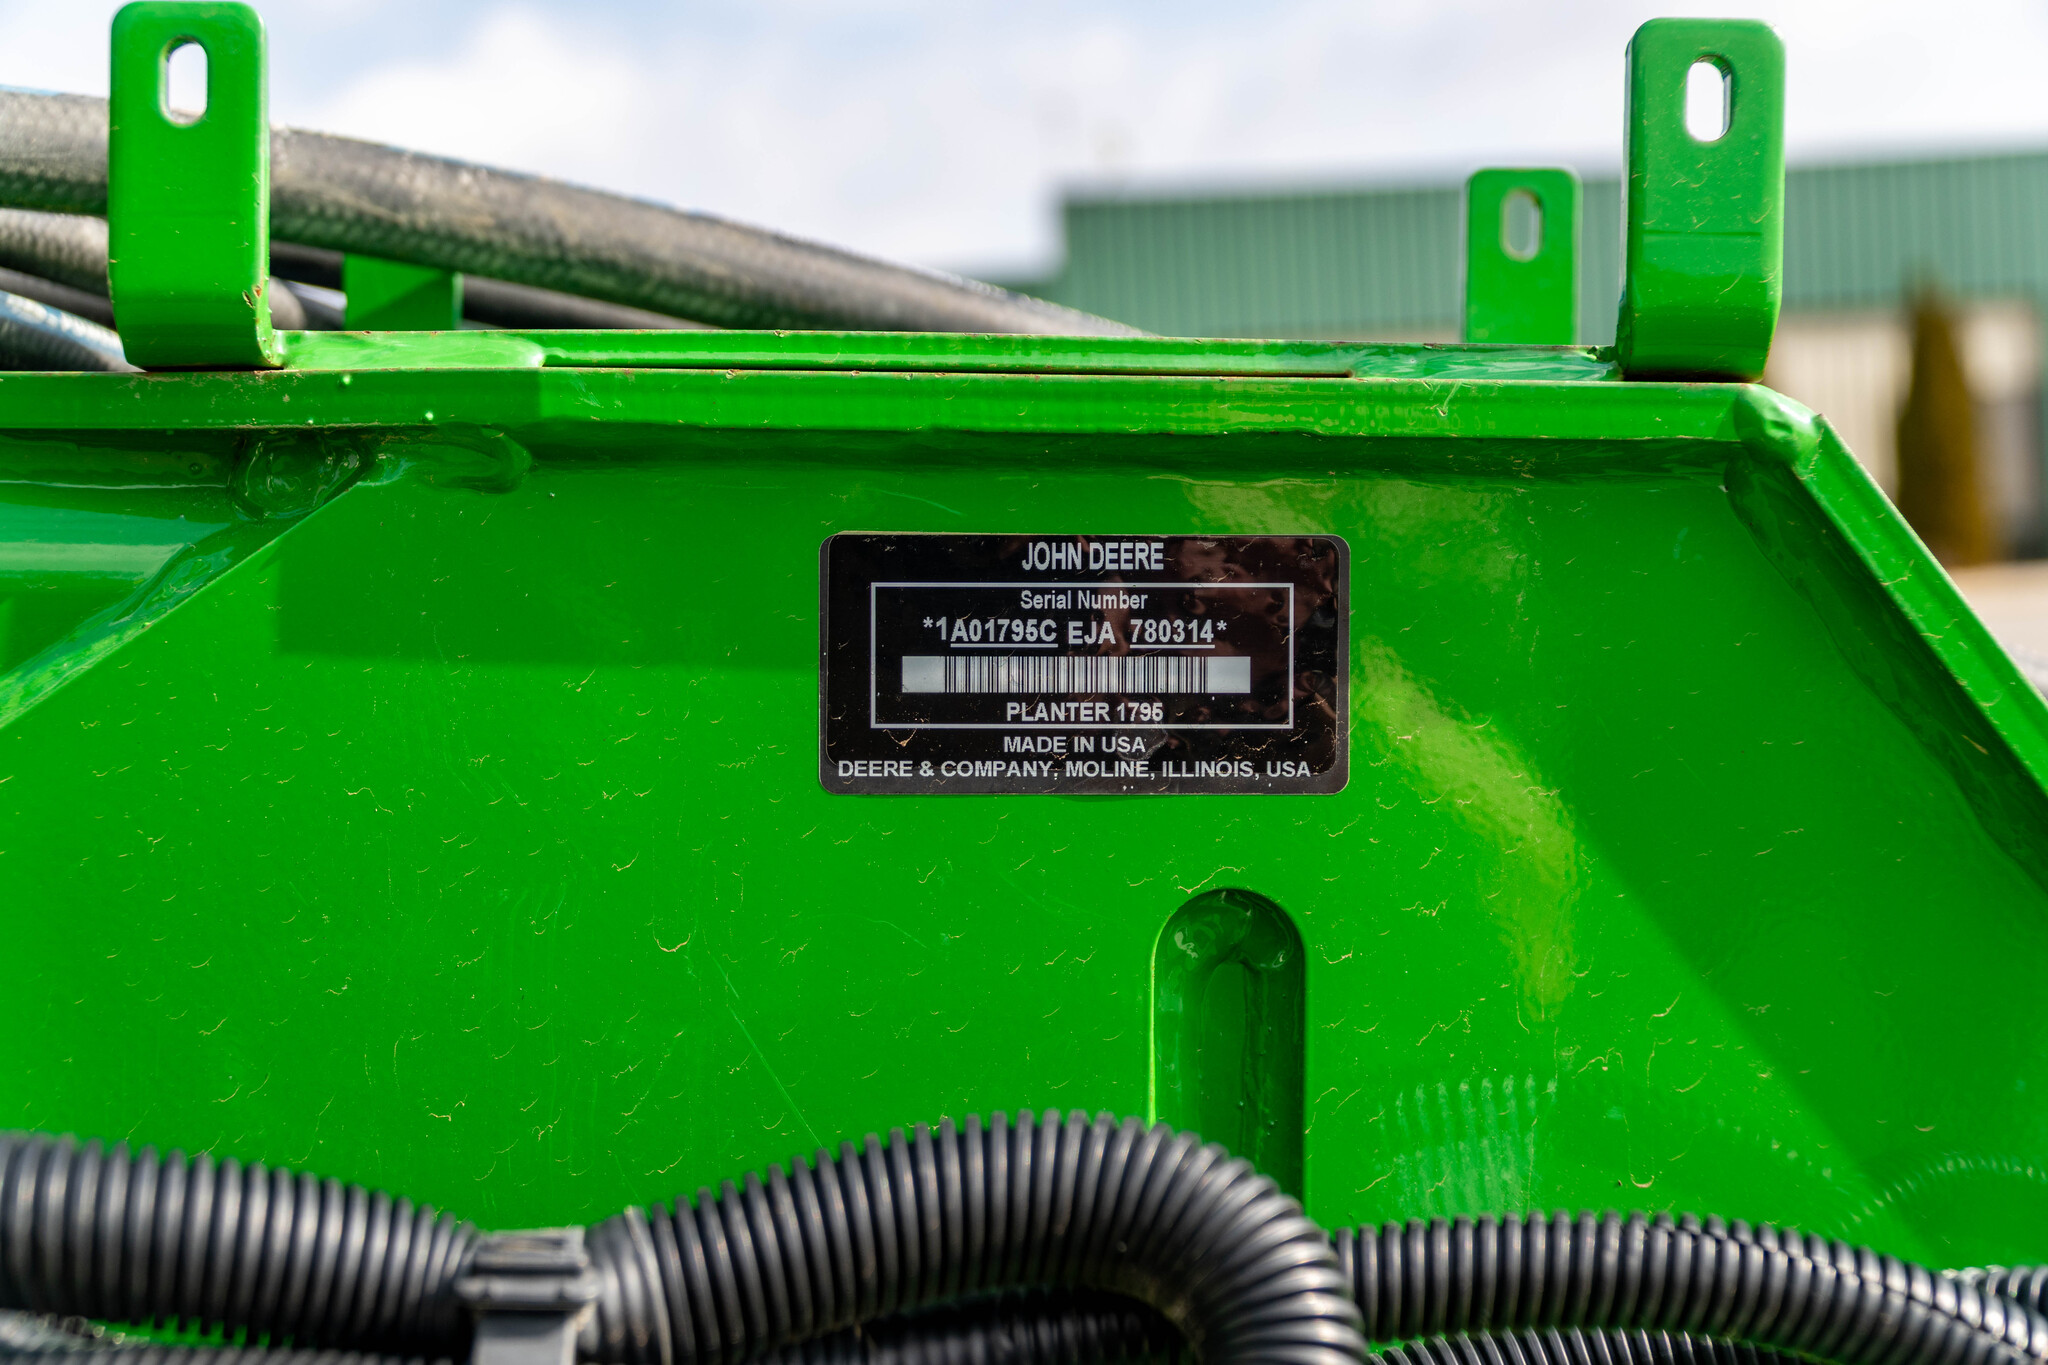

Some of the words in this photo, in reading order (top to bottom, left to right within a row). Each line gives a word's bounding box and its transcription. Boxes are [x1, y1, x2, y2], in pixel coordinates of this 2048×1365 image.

[1022, 541, 1082, 571] JOHN
[1090, 542, 1164, 570] DEERE
[1020, 590, 1072, 610] Serial
[1078, 590, 1148, 610] Number
[1068, 621, 1116, 645] EJA
[1006, 702, 1111, 722] PLANTER
[1117, 702, 1164, 722] 1795
[1004, 736, 1067, 754] MADE
[1074, 736, 1095, 754] IN
[1101, 736, 1146, 754] USA
[838, 760, 913, 778] DEERE
[920, 760, 934, 778] &
[1065, 760, 1155, 781] MOLINE,
[1162, 760, 1260, 781] ILLINOIS,
[1266, 760, 1311, 778] USA
